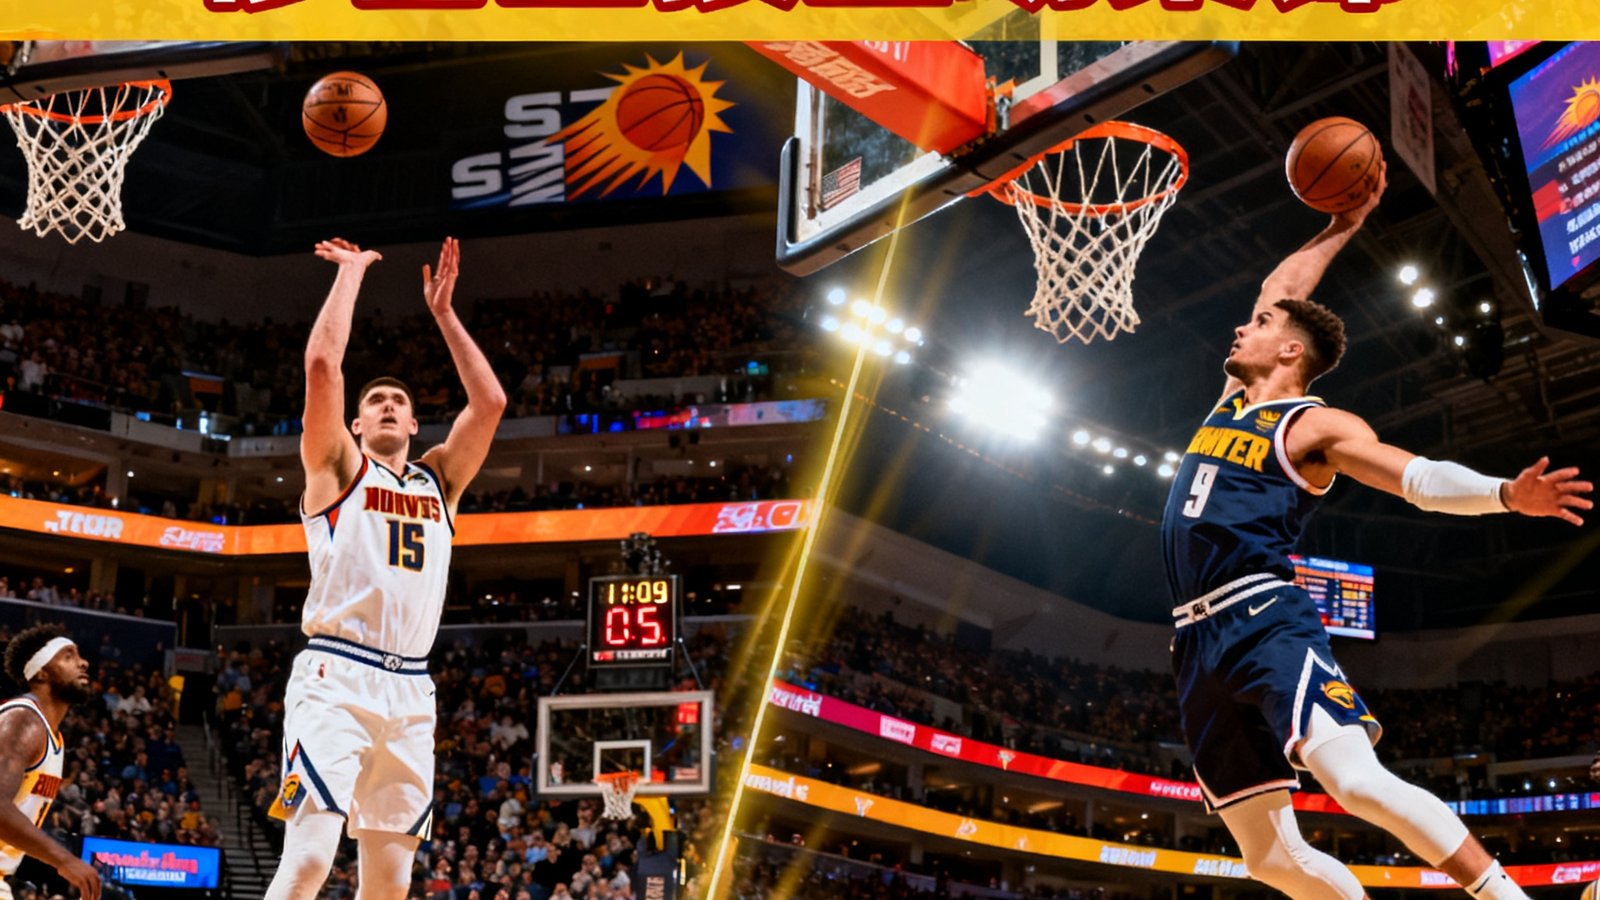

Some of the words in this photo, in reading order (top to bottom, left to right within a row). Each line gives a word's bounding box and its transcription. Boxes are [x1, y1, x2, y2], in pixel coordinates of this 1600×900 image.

[1182, 463, 1219, 518] 9
[387, 519, 425, 573] 15
[608, 581, 668, 604] 11:09
